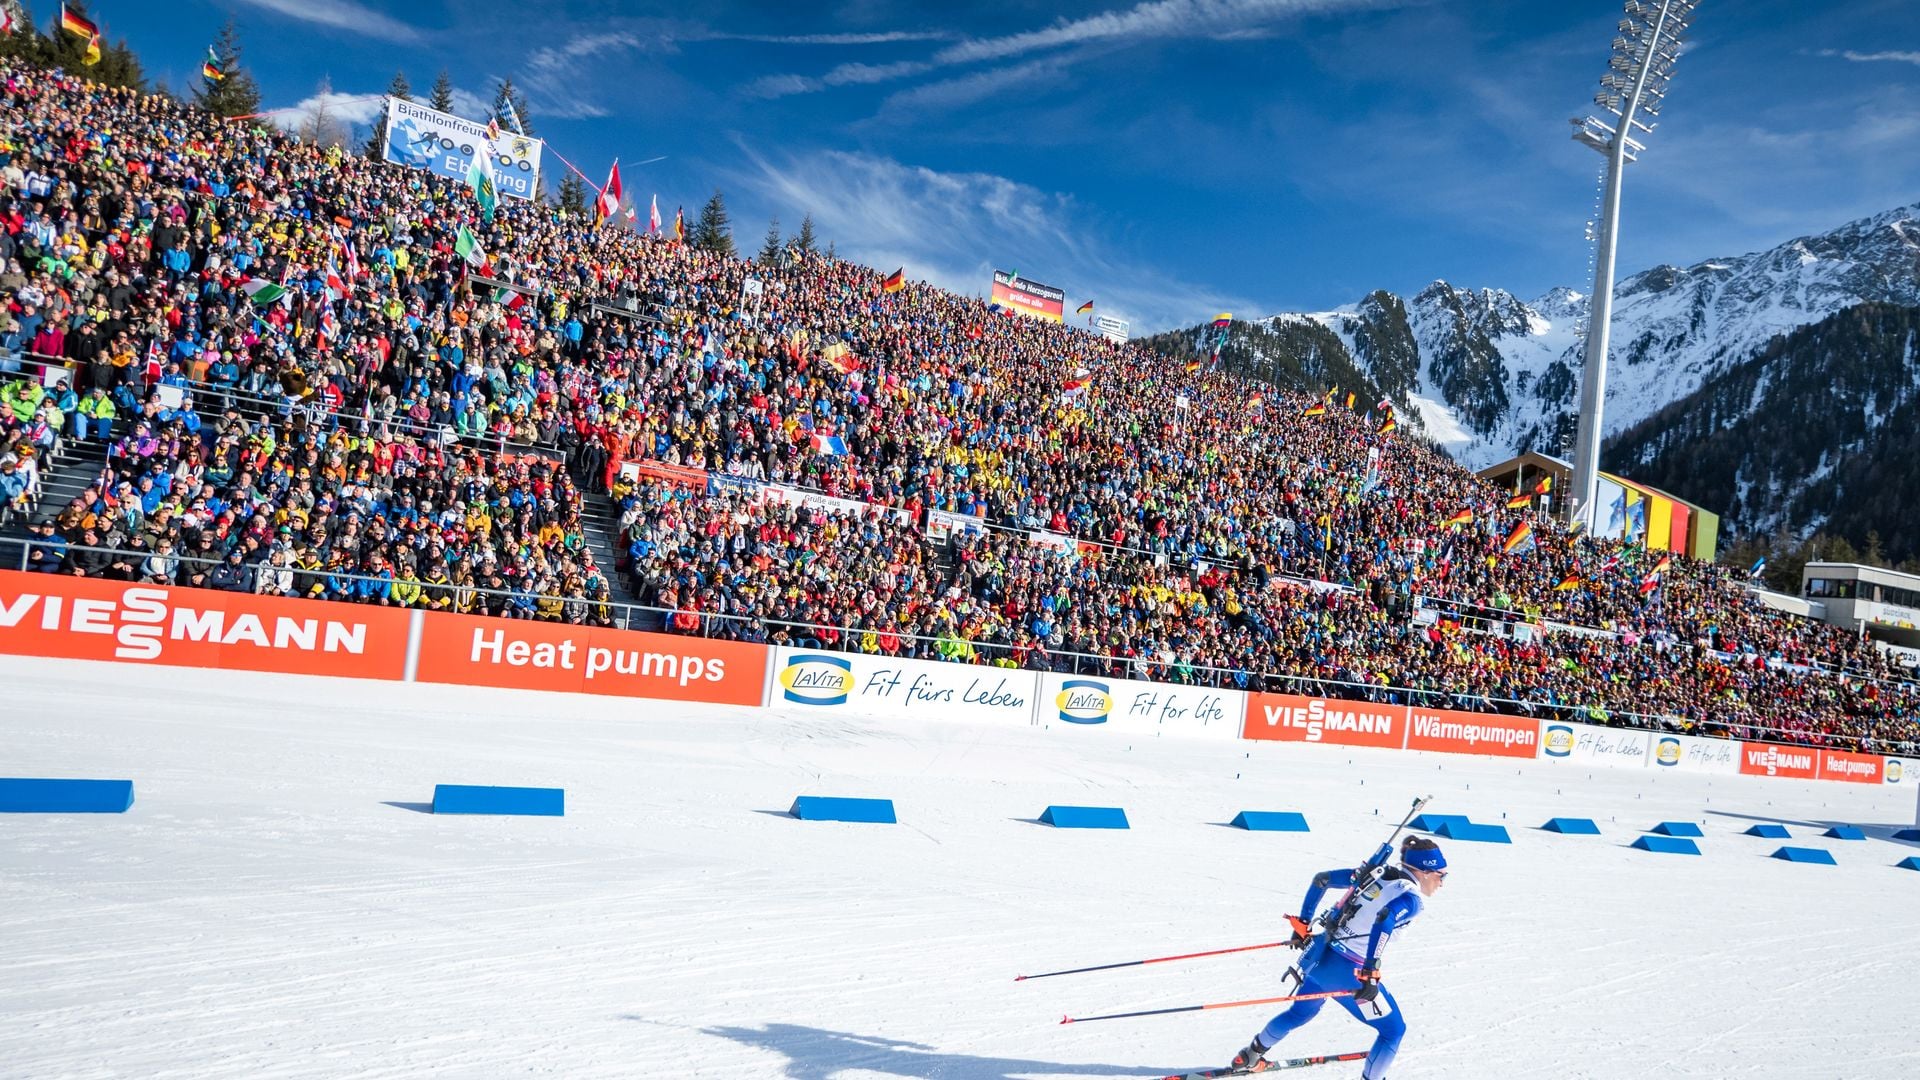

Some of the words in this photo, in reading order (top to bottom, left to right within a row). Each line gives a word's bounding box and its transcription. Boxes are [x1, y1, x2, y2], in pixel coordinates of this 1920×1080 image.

[398, 103, 500, 141] Biathlonfreun
[445, 156, 527, 192] Ebfing
[995, 273, 1026, 290] Skifnde
[1009, 293, 1031, 305] grüßen
[1031, 299, 1043, 308] alle
[805, 494, 827, 505] Grüße
[0, 588, 367, 659] VIESSMANN
[470, 628, 576, 669] Heat
[585, 647, 725, 686] pumps
[1900, 652, 1916, 662] 026
[862, 669, 902, 697] Fit
[905, 673, 954, 707] fürs
[962, 677, 1024, 708] Leben
[1129, 692, 1158, 716] Fit
[1160, 695, 1188, 724] for
[1194, 695, 1224, 726] life
[1263, 700, 1392, 741] VIESSMANN
[1414, 714, 1535, 748] Wärmepumpen
[1577, 733, 1592, 750] Fit
[1592, 735, 1614, 757] fürs
[1616, 736, 1643, 756] Leben
[1748, 746, 1811, 775] VIESSMANN
[1827, 755, 1847, 773] Heat
[1847, 761, 1876, 776] pumps
[1372, 1000, 1382, 1016] 4
